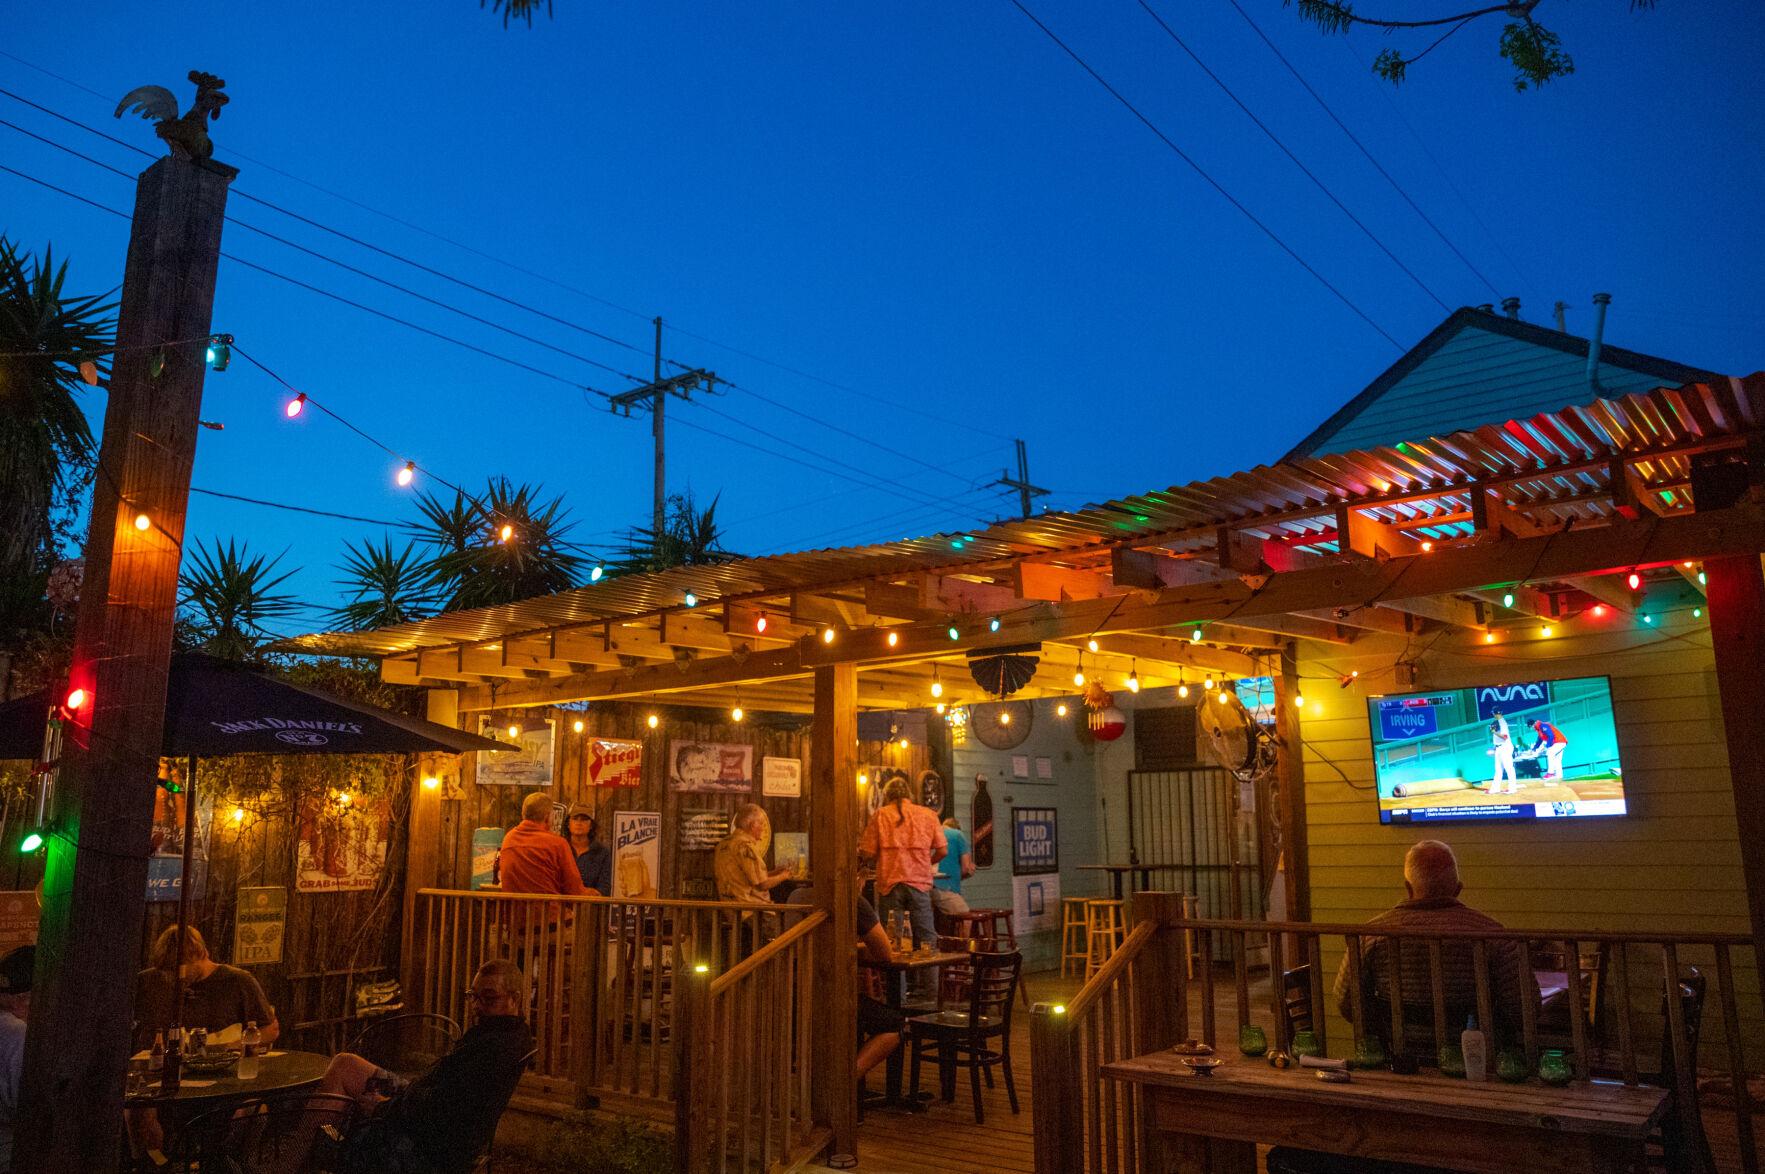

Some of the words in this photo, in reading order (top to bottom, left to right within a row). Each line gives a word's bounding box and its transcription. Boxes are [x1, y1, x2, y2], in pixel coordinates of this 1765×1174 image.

[1480, 684, 1544, 702] nuna
[210, 720, 271, 734] JACK
[264, 717, 363, 734] DANIEL'S
[1390, 714, 1425, 726] IRVING
[589, 741, 640, 784] Stiegl
[619, 770, 640, 785] Bier
[621, 820, 636, 833] LA
[638, 817, 657, 827] VRAIE
[1024, 825, 1047, 840] BUD
[618, 827, 658, 849] BLANCHE
[1020, 841, 1052, 857] LIGHT
[149, 879, 169, 888] WE
[300, 880, 331, 888] GRAB
[240, 912, 281, 922] RANGER
[245, 946, 273, 959] IPA
